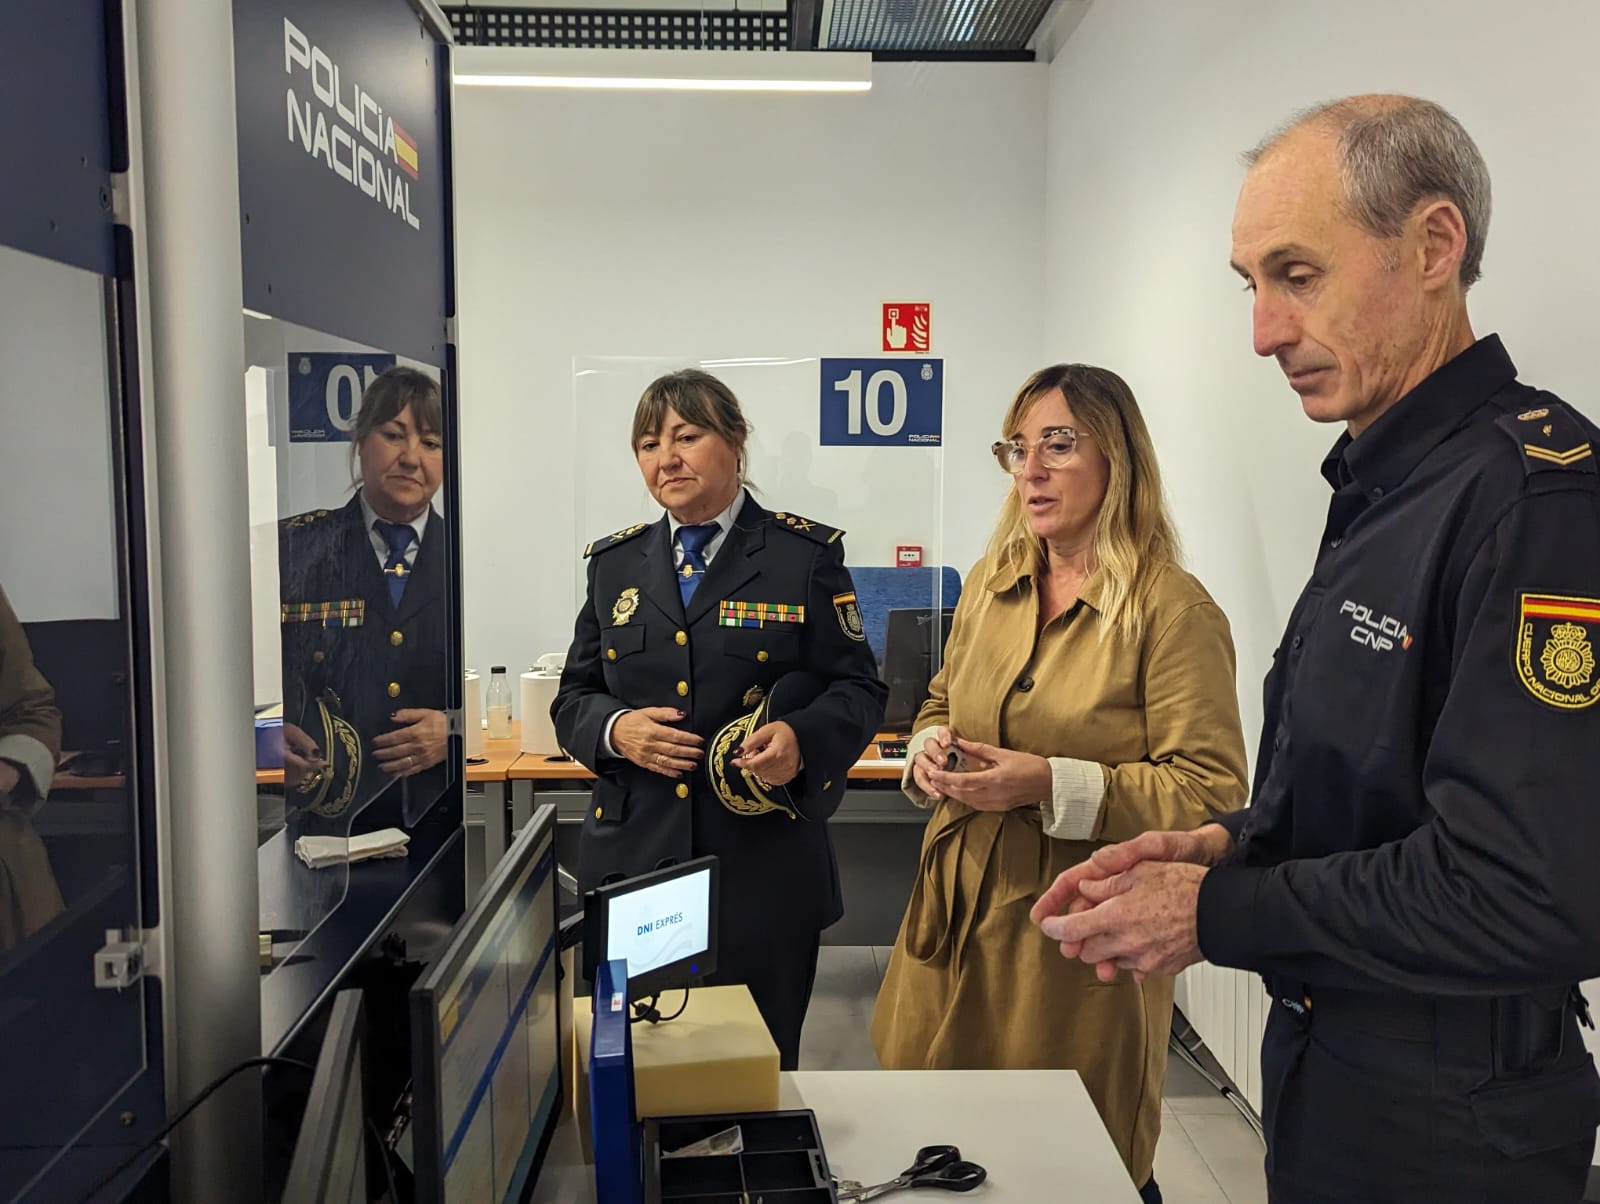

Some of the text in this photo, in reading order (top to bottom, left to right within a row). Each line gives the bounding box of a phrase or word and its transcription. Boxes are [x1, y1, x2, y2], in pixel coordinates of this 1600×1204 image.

[287, 88, 419, 230] NACIONAL
[834, 369, 908, 436] 10
[1339, 599, 1408, 640] POLICIA
[1350, 625, 1394, 651] CNP
[1521, 622, 1534, 676] CUERPO
[1528, 676, 1590, 703] NACIONAL
[637, 921, 653, 936] DNI
